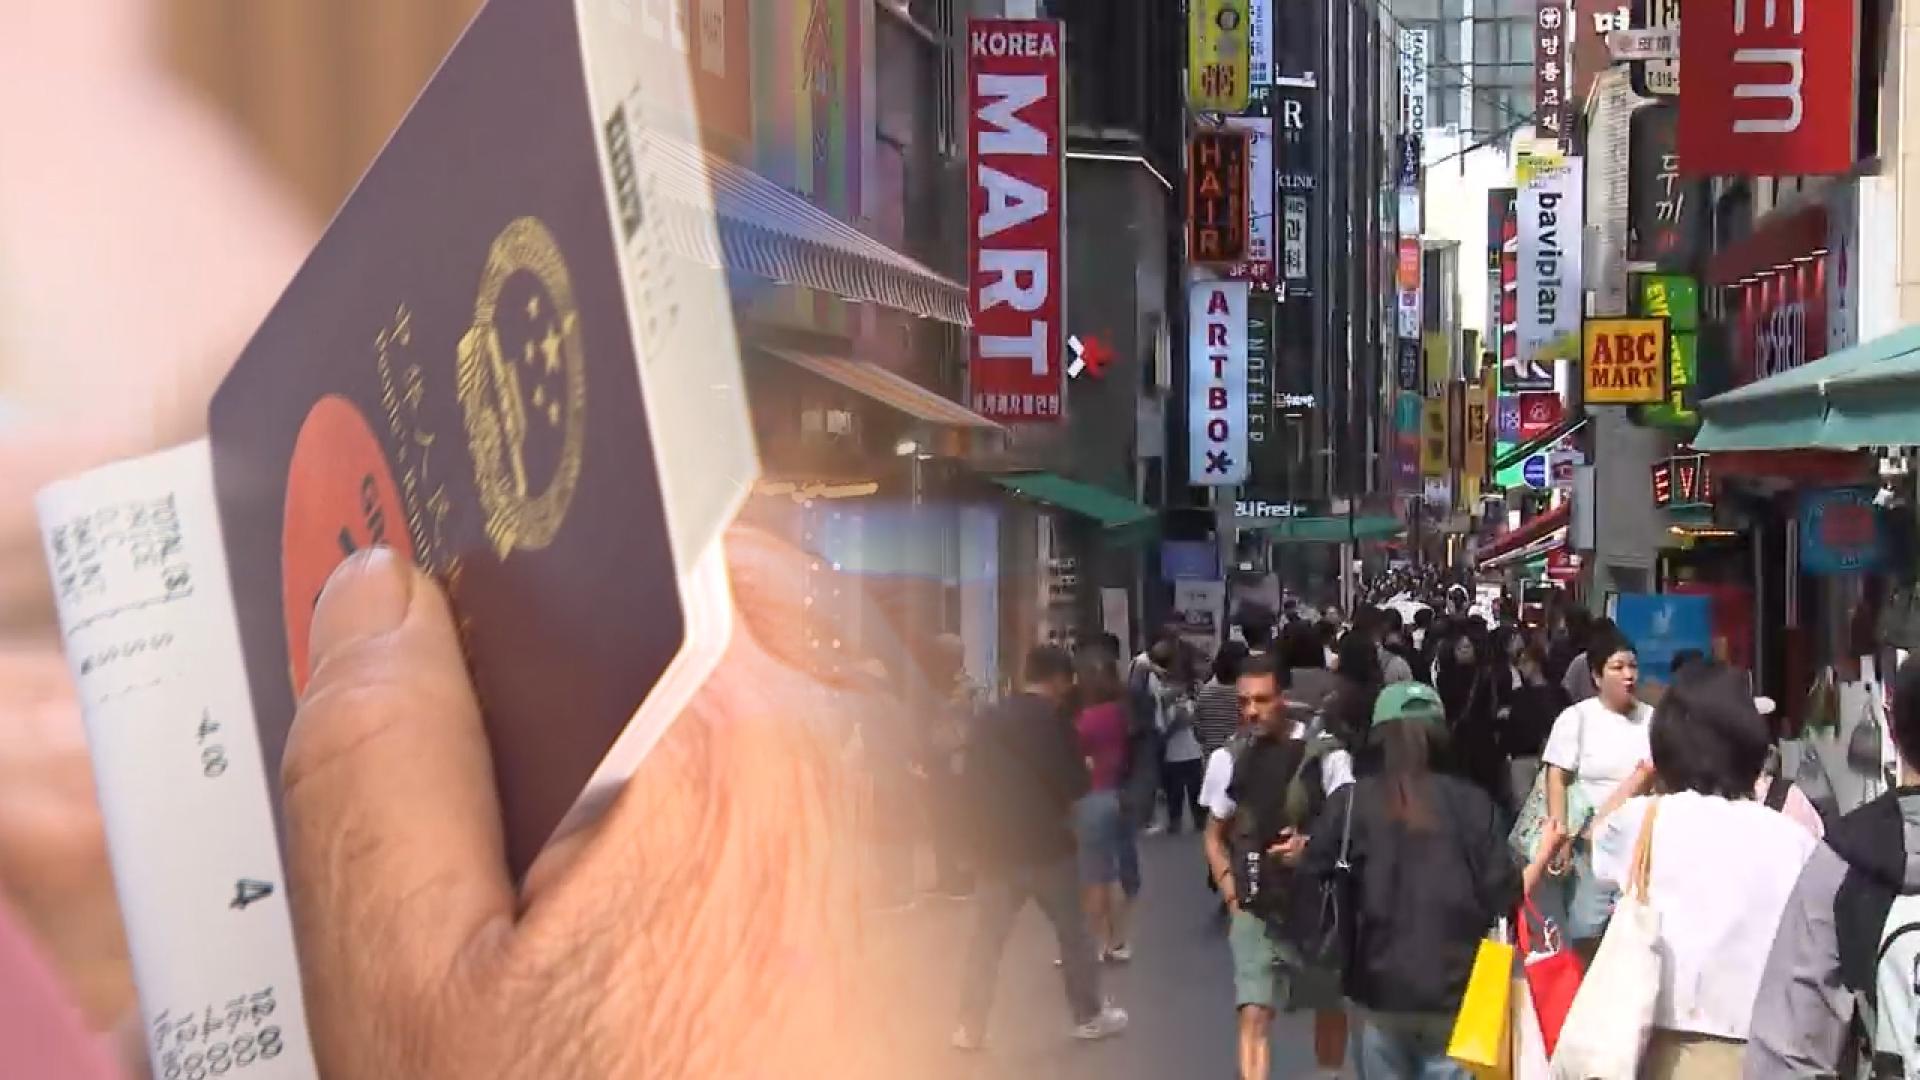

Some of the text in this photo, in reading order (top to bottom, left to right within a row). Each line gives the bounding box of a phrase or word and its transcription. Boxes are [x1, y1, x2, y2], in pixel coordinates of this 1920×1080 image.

[971, 32, 1057, 58] KOREA
[1284, 100, 1303, 129] R
[977, 74, 1049, 376] MART
[1536, 191, 1563, 325] baviplan
[1591, 333, 1656, 365] ABC
[1206, 290, 1233, 475] ARTBOX
[1591, 367, 1657, 388] MART
[229, 878, 274, 910] 4
